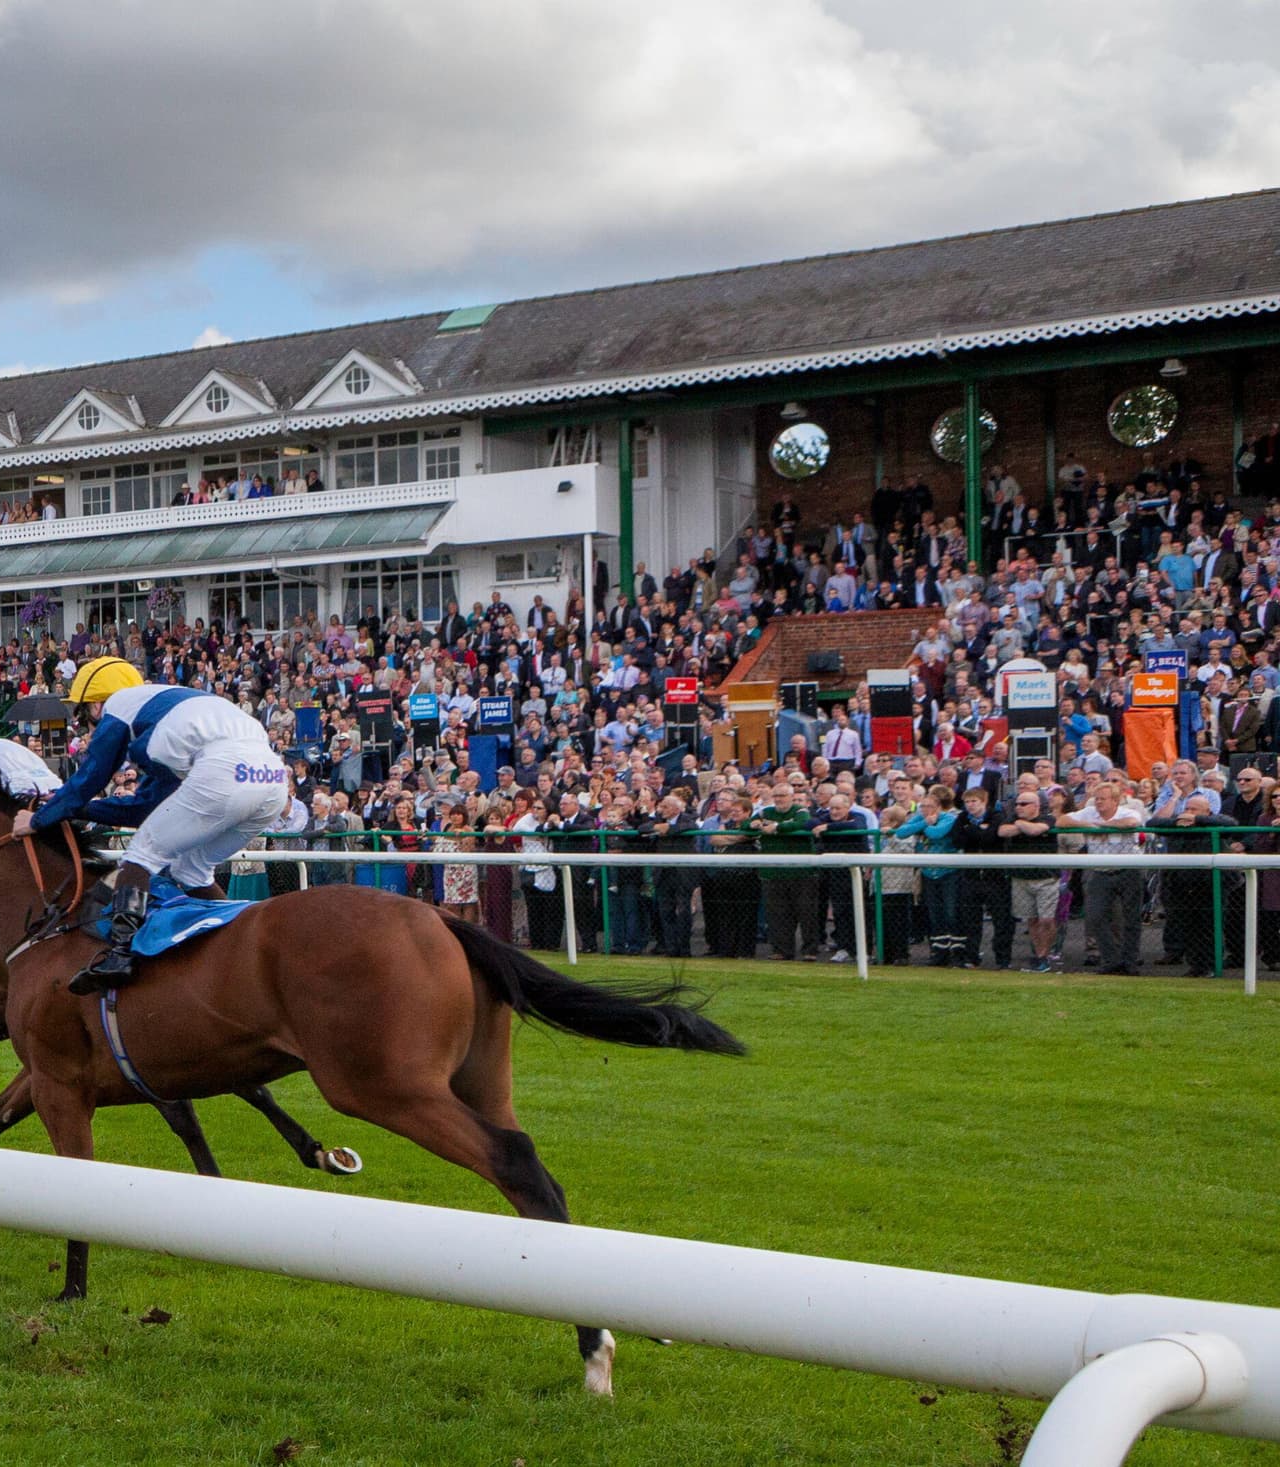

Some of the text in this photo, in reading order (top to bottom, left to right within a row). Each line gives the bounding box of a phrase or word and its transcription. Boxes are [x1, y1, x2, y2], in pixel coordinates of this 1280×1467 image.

[1016, 680, 1047, 689] Mark
[1013, 692, 1052, 701] Peters
[482, 701, 509, 709] STUART
[484, 709, 508, 719] JAMES
